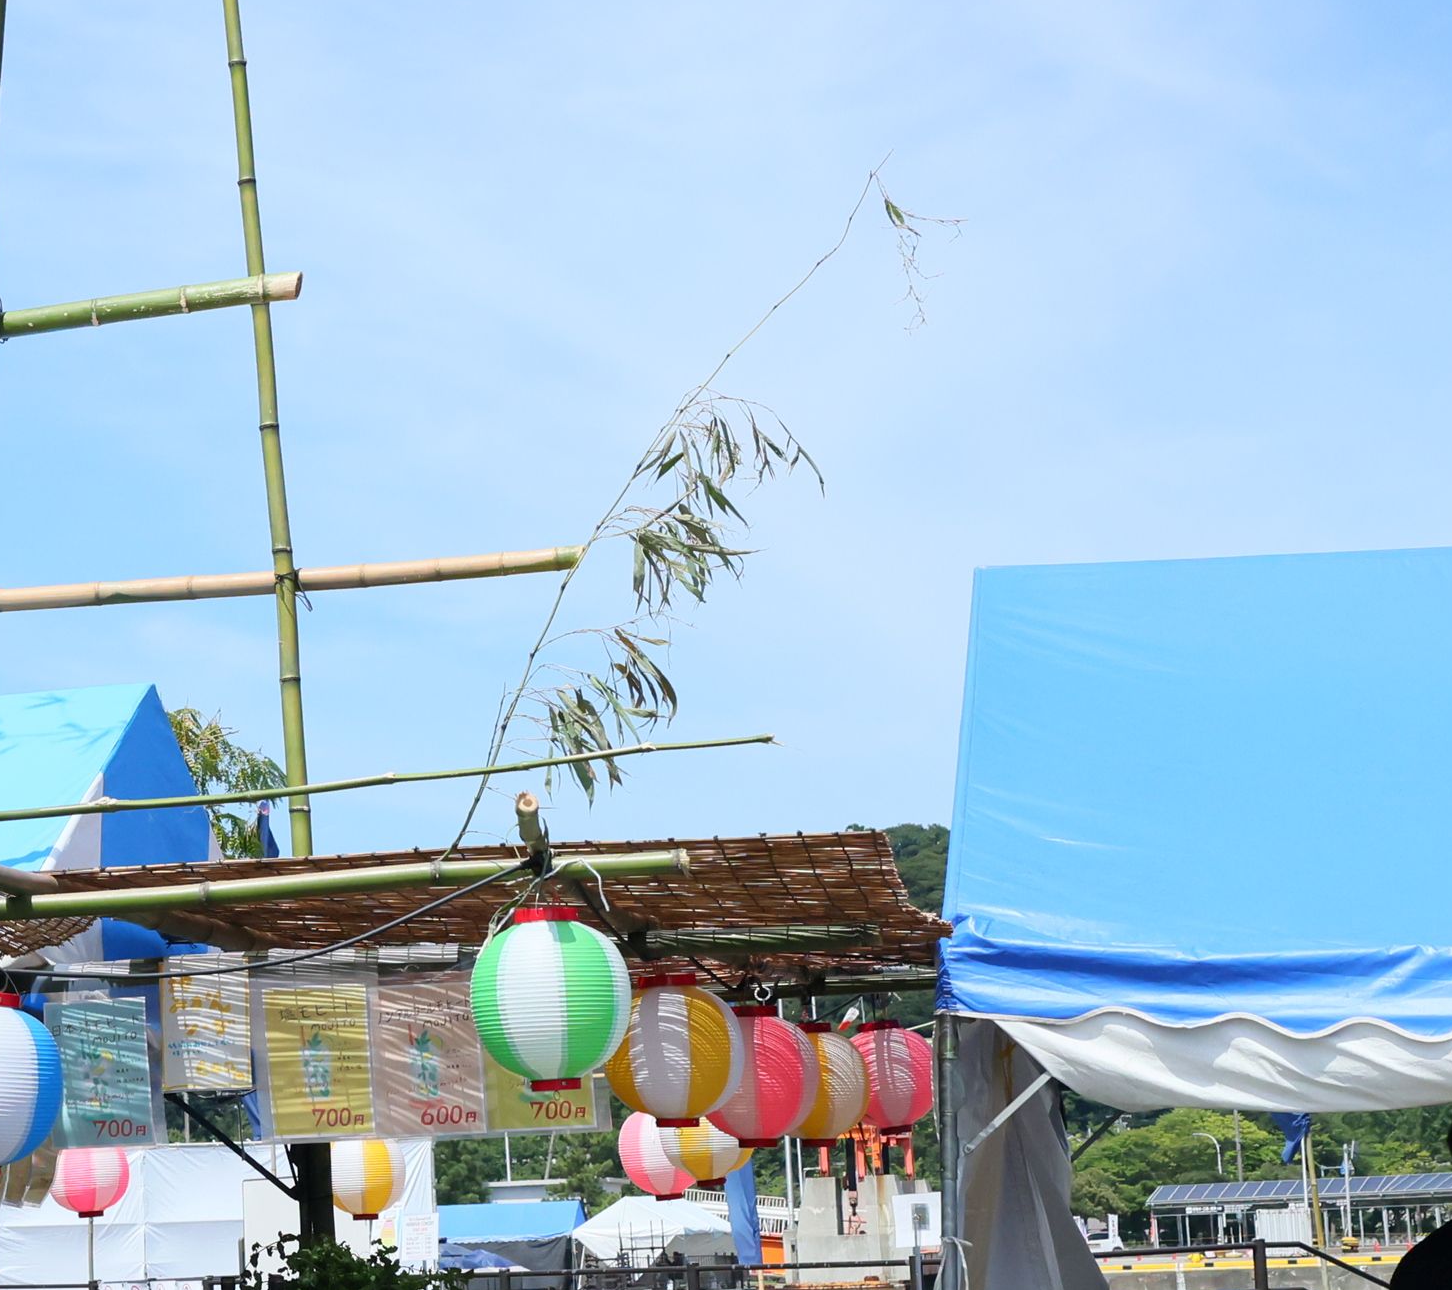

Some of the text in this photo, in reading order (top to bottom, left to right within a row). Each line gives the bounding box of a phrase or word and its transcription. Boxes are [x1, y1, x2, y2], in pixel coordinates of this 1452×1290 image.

[312, 1107, 365, 1128] 700円
[420, 1104, 477, 1126] 600円
[529, 1100, 586, 1120] 700円
[92, 1119, 147, 1139] 700円
